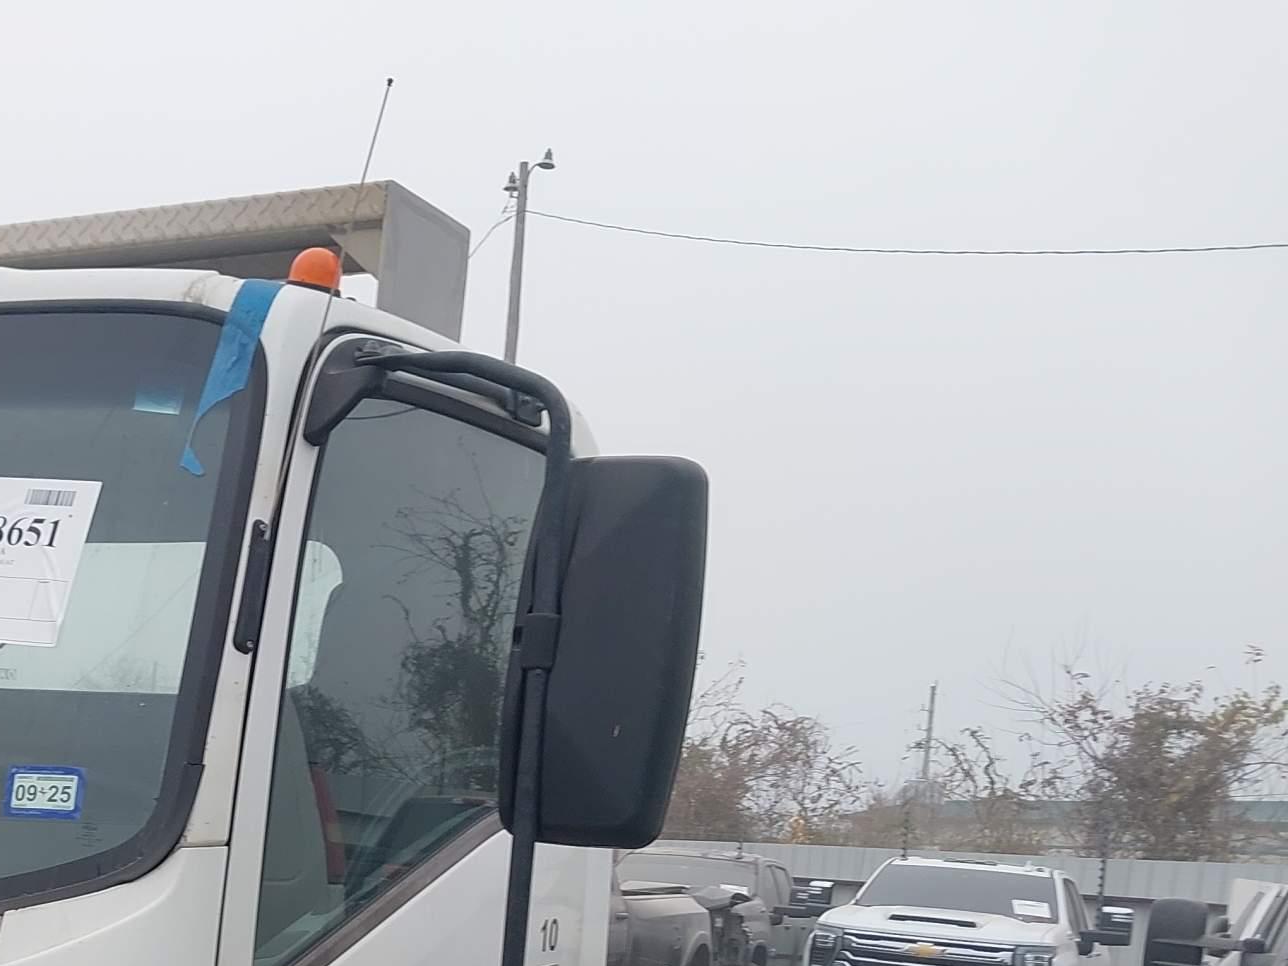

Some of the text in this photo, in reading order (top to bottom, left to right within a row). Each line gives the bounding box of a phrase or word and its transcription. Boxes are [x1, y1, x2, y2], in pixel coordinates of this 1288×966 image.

[15, 784, 73, 803] 09 25
[540, 918, 559, 952] 10
